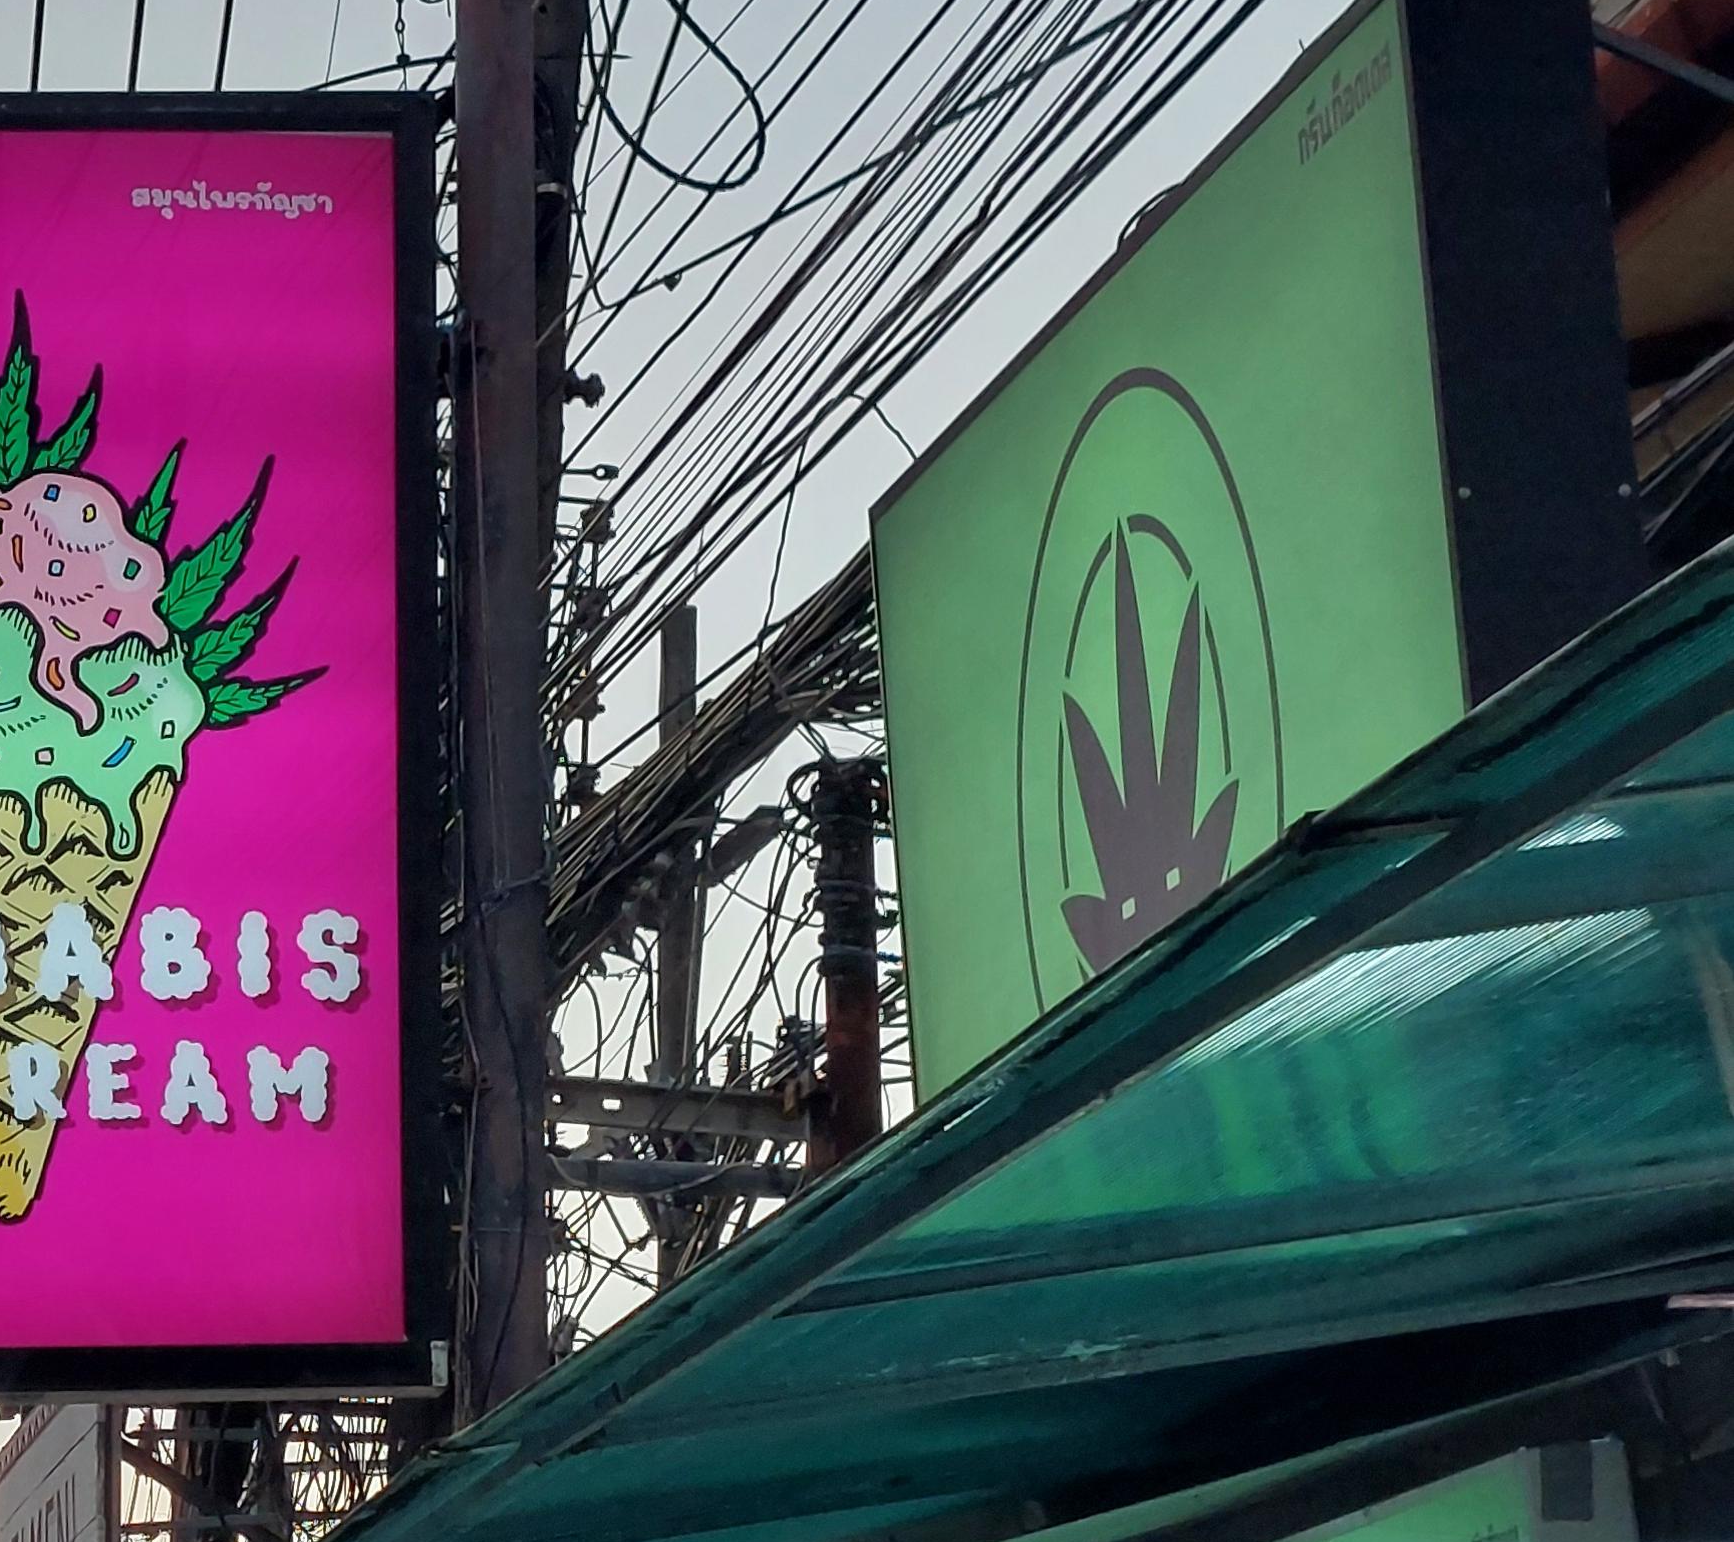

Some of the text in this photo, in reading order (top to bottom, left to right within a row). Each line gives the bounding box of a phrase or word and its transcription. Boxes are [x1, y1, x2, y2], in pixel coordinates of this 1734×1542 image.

[130, 179, 334, 220] สมุนไพรกัญชา
